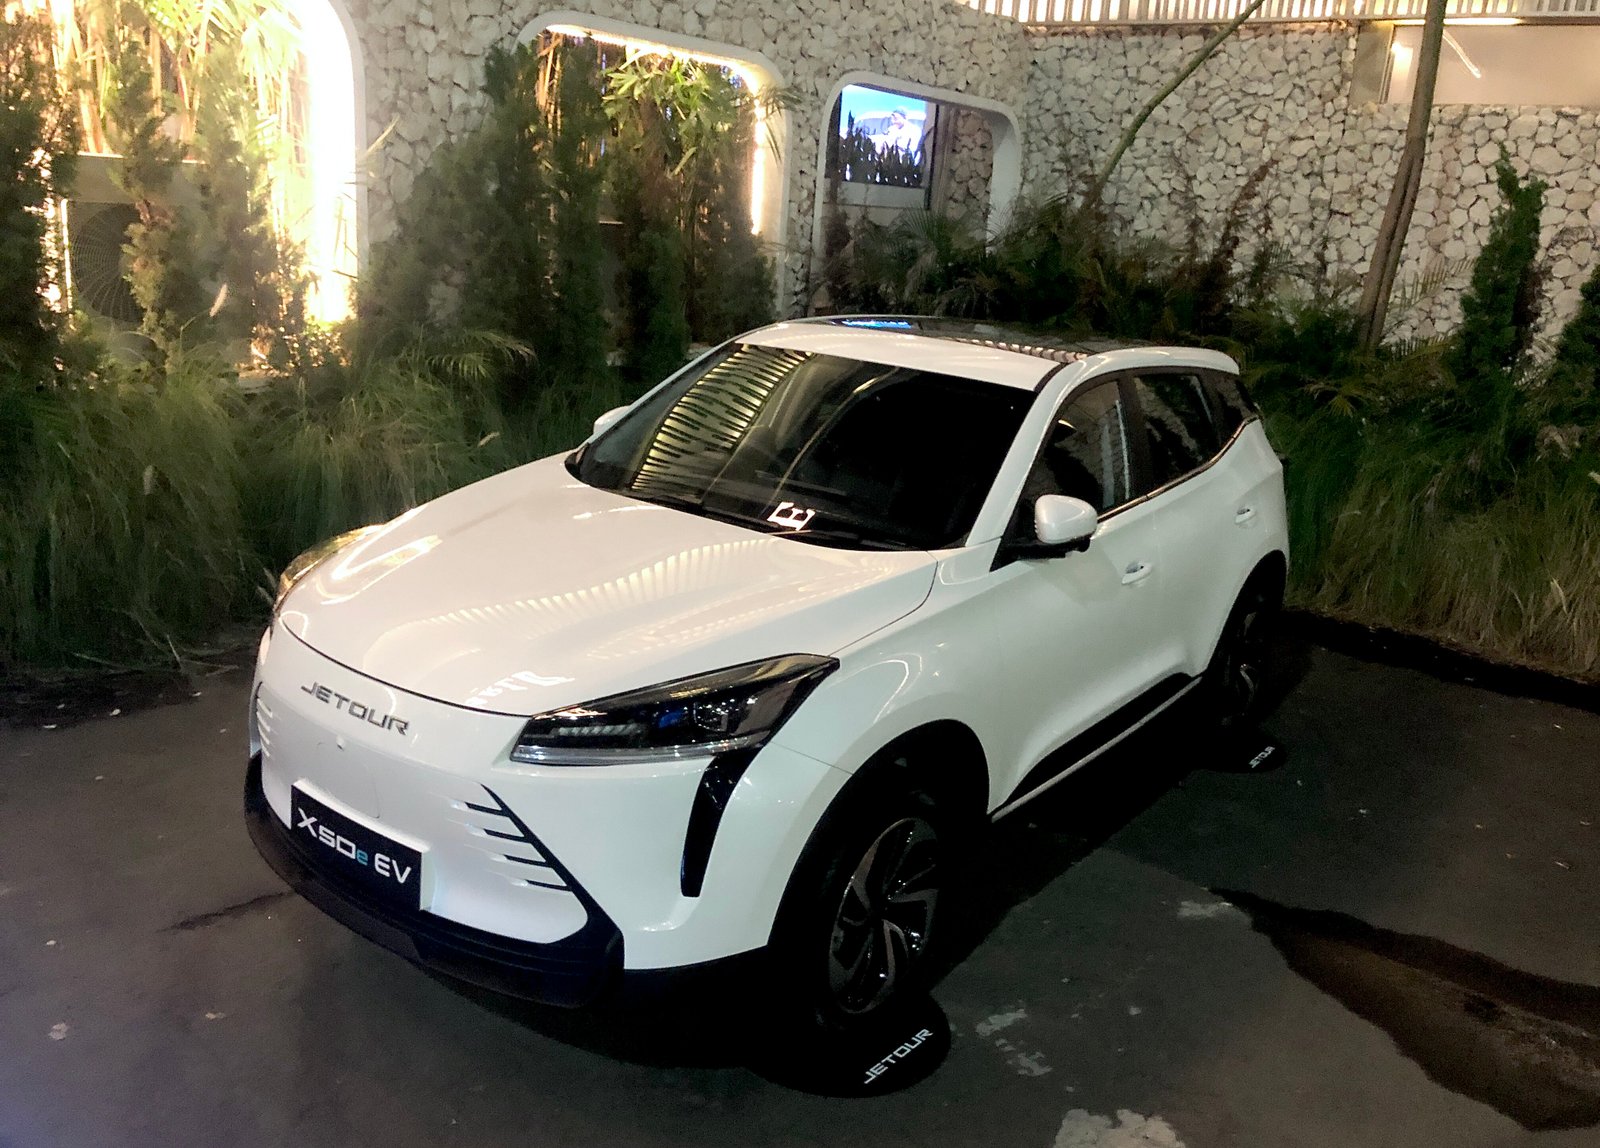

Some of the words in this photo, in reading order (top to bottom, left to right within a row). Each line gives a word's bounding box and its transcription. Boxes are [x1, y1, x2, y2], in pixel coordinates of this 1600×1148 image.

[301, 682, 409, 736] JETOUR
[297, 807, 369, 866] X50e
[374, 853, 411, 884] EV
[864, 1028, 934, 1084] JETOUR
